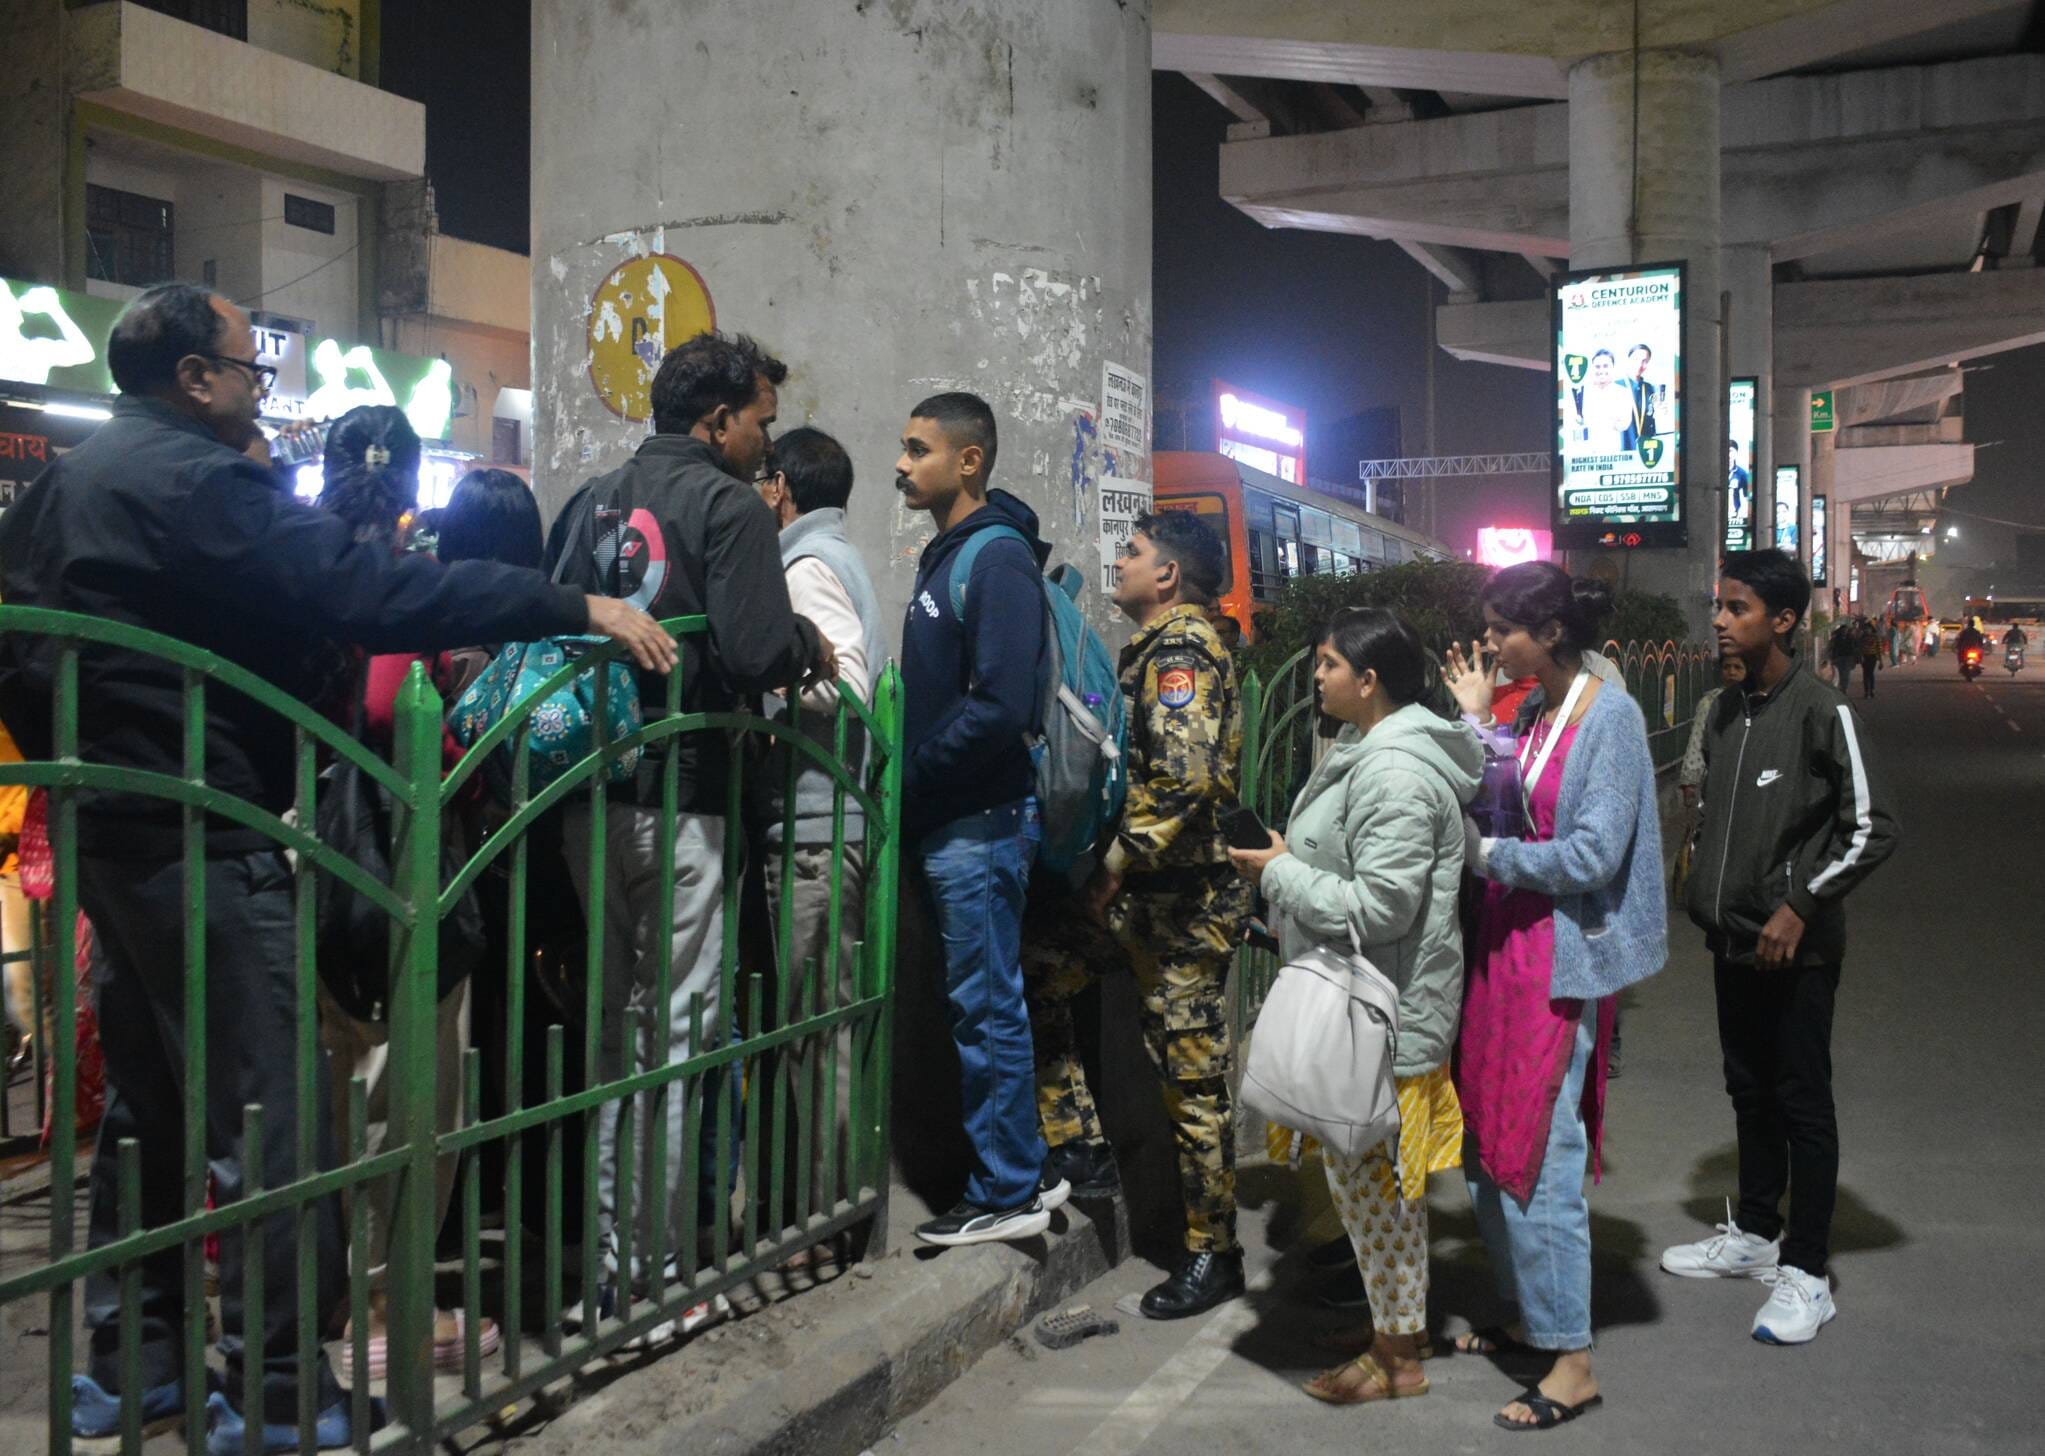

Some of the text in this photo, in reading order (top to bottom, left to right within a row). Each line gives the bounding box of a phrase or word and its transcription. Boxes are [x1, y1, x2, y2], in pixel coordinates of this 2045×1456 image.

[1591, 283, 1669, 300] CENTURION
[1591, 294, 1669, 309] DEFENCE ACADEMY
[1571, 454, 1633, 464] HIGHEST SELECTION
[1596, 463, 1613, 471] INDIA
[1575, 491, 1662, 503] NDA CDS SSB MNS
[1102, 519, 1129, 541] कानपुर
